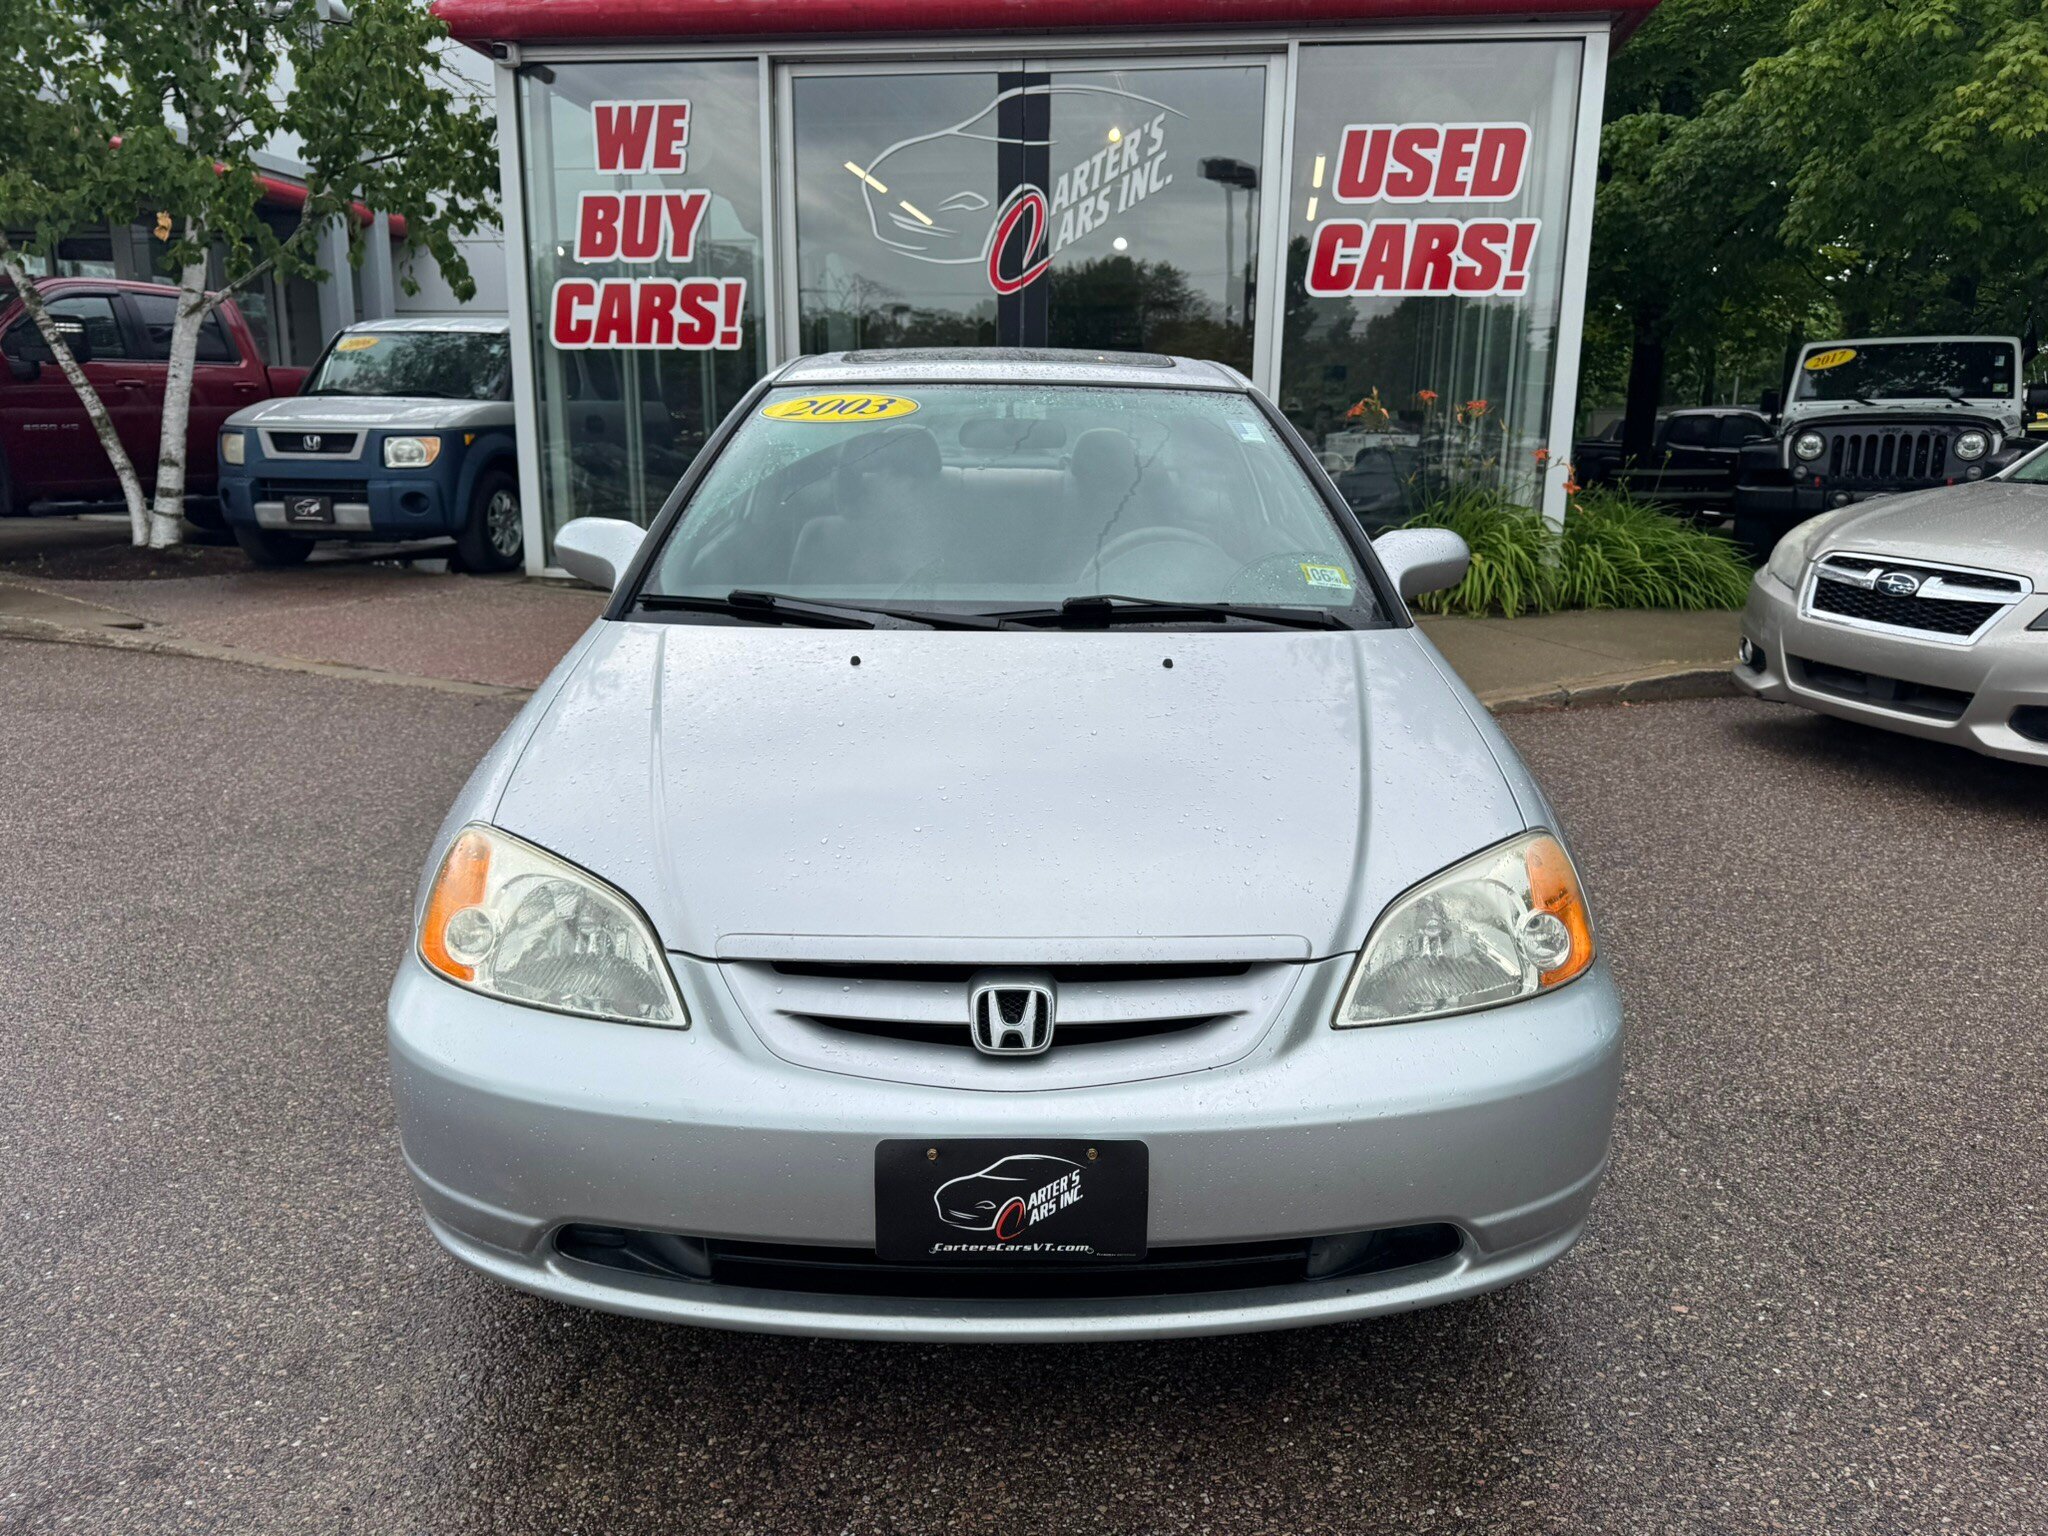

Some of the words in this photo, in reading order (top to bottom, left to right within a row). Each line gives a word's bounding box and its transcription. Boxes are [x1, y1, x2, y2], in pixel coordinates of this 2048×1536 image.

[593, 103, 688, 171] WE
[1336, 126, 1528, 199] USED
[1117, 150, 1174, 215] INC.
[577, 193, 708, 260] BUY
[1308, 222, 1539, 293] CARS!
[552, 281, 744, 346] CARS!
[1812, 350, 1848, 369] 2017
[780, 398, 897, 417] 2003
[1059, 1184, 1084, 1210] INC.
[933, 1242, 1091, 1253] CartersCarsVT.com
